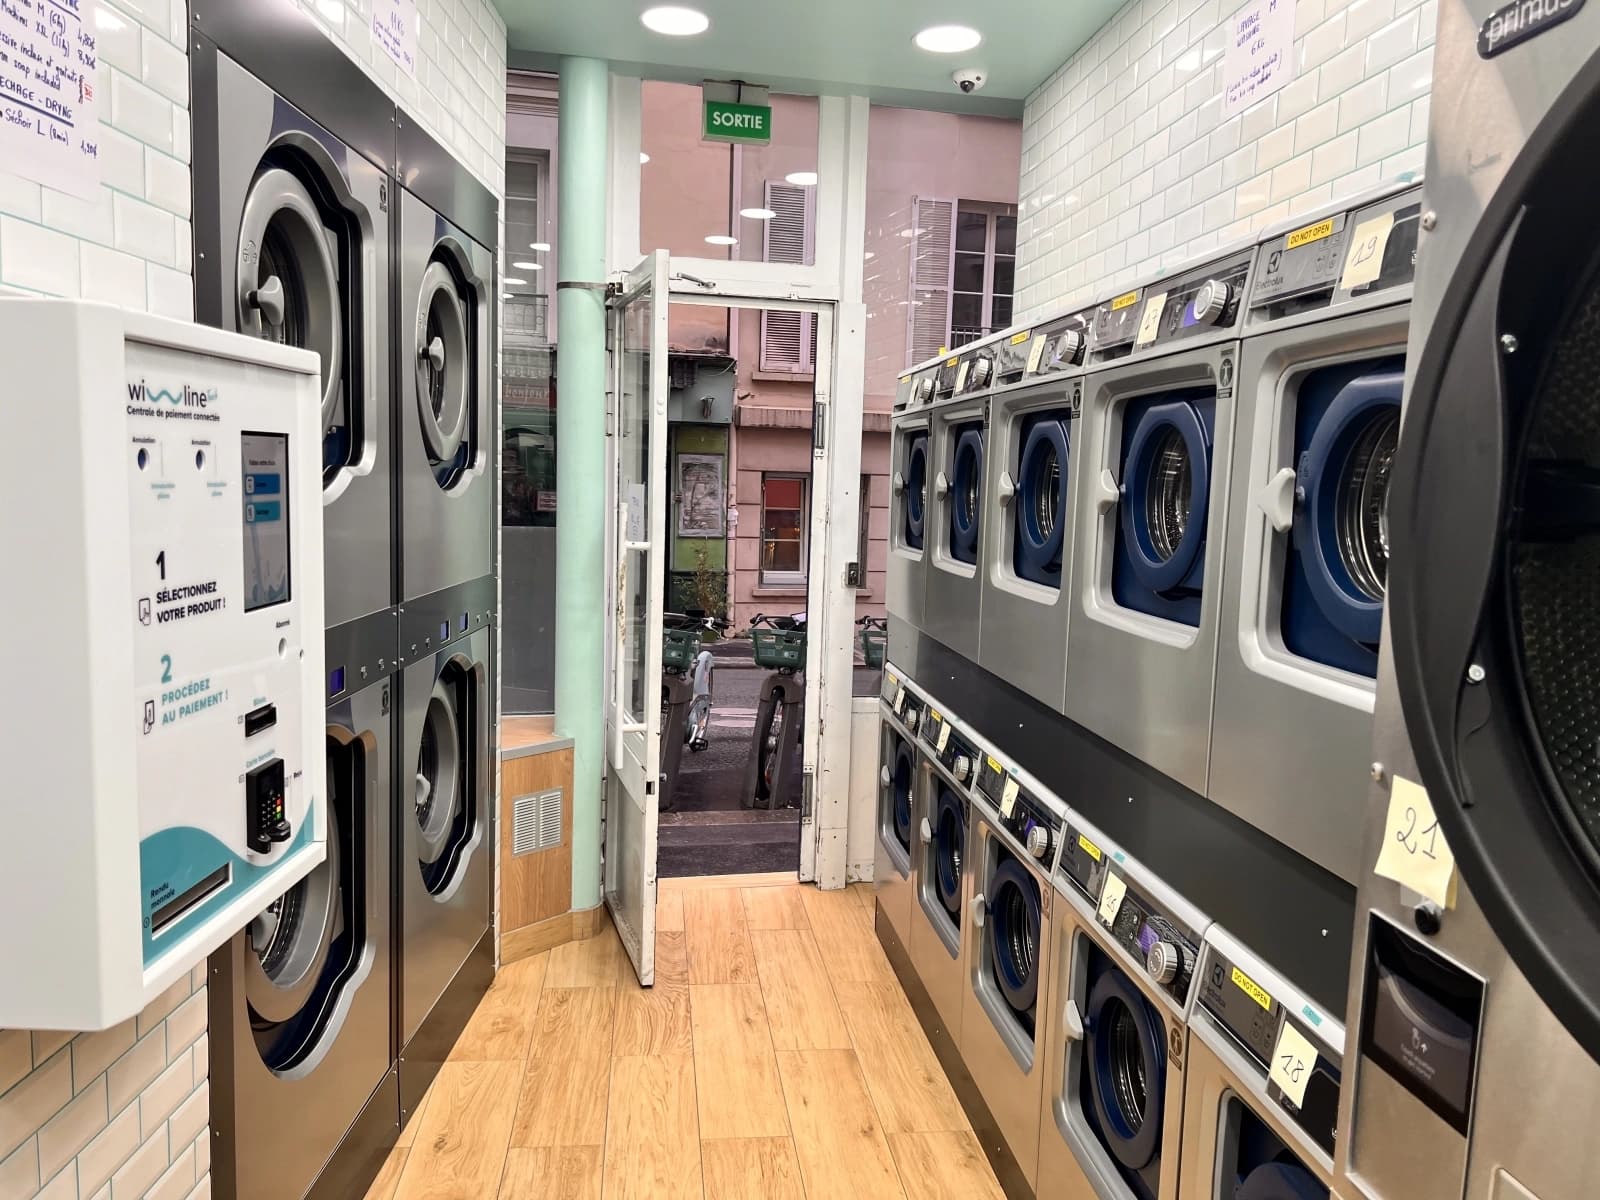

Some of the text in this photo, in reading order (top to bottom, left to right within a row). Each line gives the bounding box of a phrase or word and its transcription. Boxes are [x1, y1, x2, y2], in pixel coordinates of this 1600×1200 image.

[713, 111, 763, 129] SORTIE
[1290, 223, 1331, 245] DO NOT OPEN
[127, 405, 155, 418] Centrale
[156, 409, 164, 418] de
[165, 409, 193, 420] paiement
[156, 551, 166, 581] 1
[156, 581, 217, 604] SÉLECTIONNEZ
[157, 603, 186, 624] VOTRE
[187, 598, 222, 617] PRODUIT
[161, 654, 173, 684] 2
[162, 678, 211, 706] PROCÉDEZ
[162, 709, 177, 725] AU
[179, 692, 224, 717] PAIEMENT
[1234, 972, 1269, 1005] DO NOT OPEN
